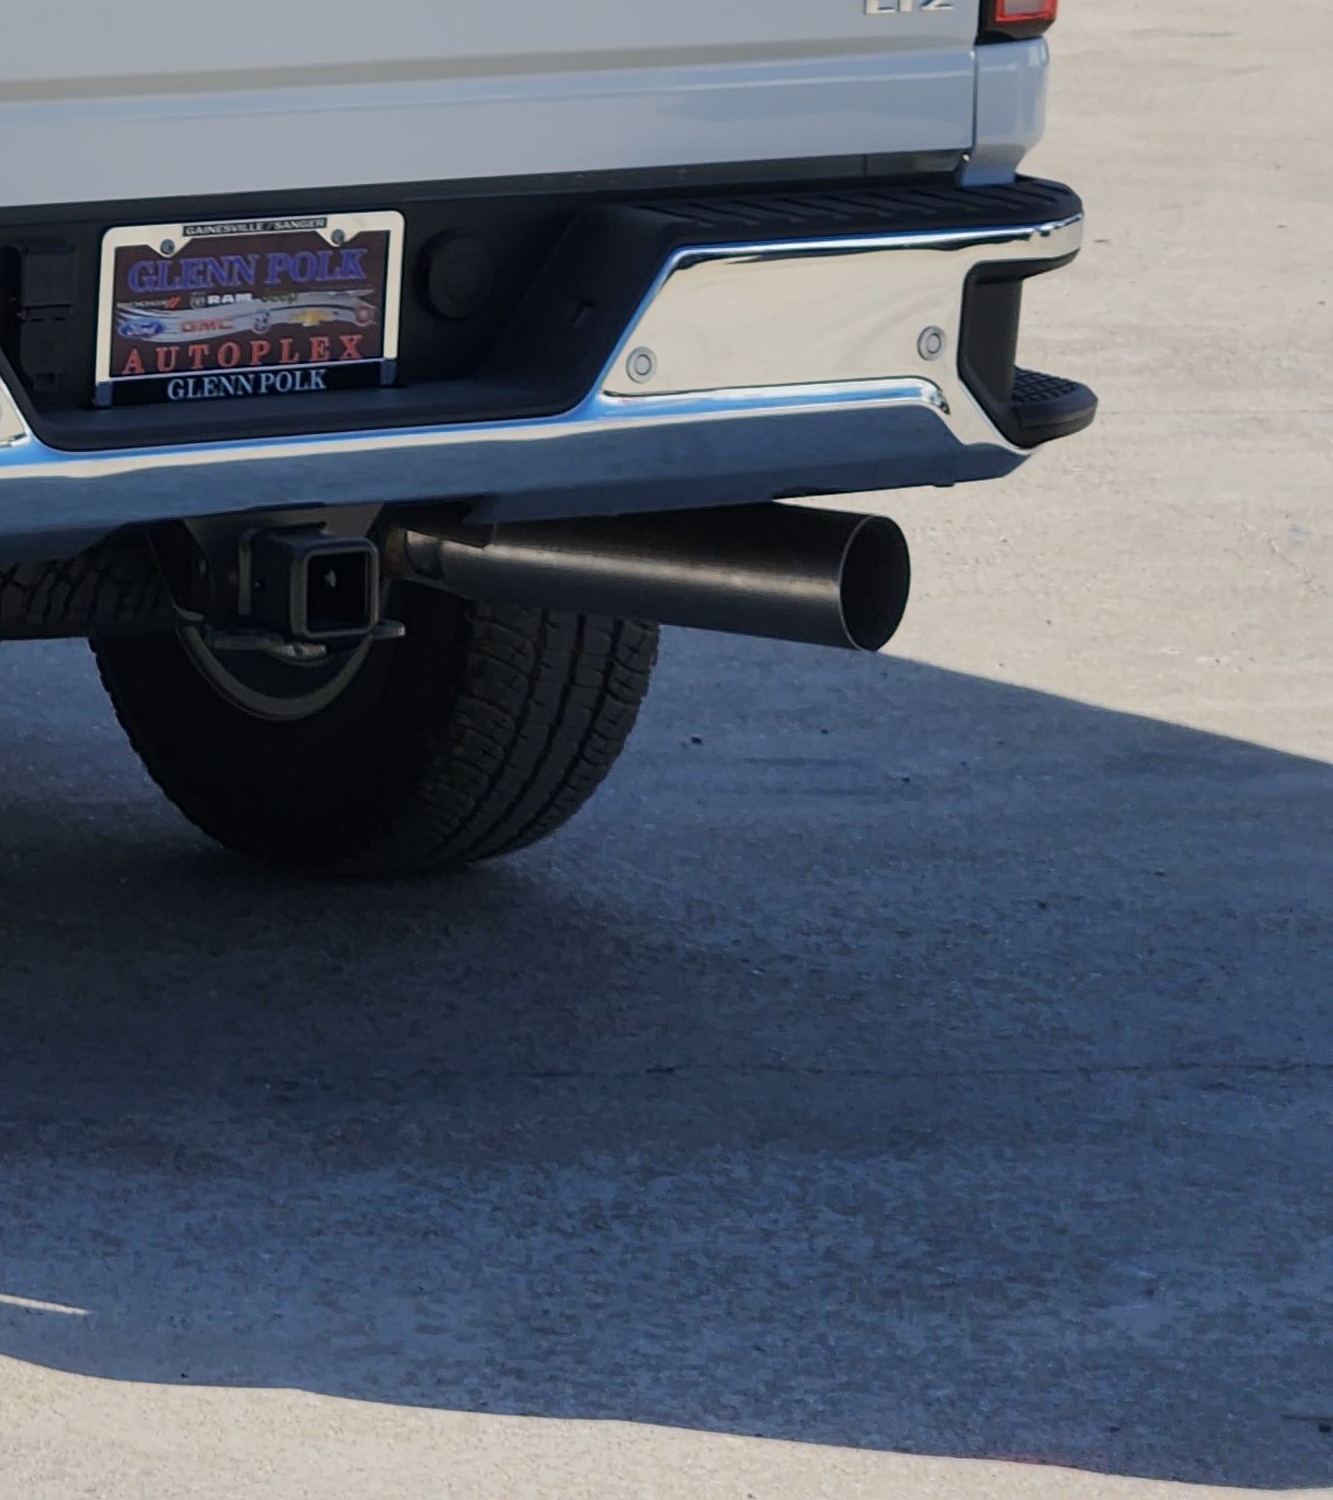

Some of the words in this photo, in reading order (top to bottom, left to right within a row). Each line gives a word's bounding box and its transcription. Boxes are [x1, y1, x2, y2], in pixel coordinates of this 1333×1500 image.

[185, 220, 264, 236] GAINESVILLE
[274, 218, 326, 230] SANGER
[127, 253, 260, 294] GLENN
[264, 247, 369, 285] POLK
[207, 292, 253, 305] RAM
[121, 334, 364, 376] AUTOPLEX
[166, 375, 254, 401] GLENN
[259, 368, 328, 395] POLK
